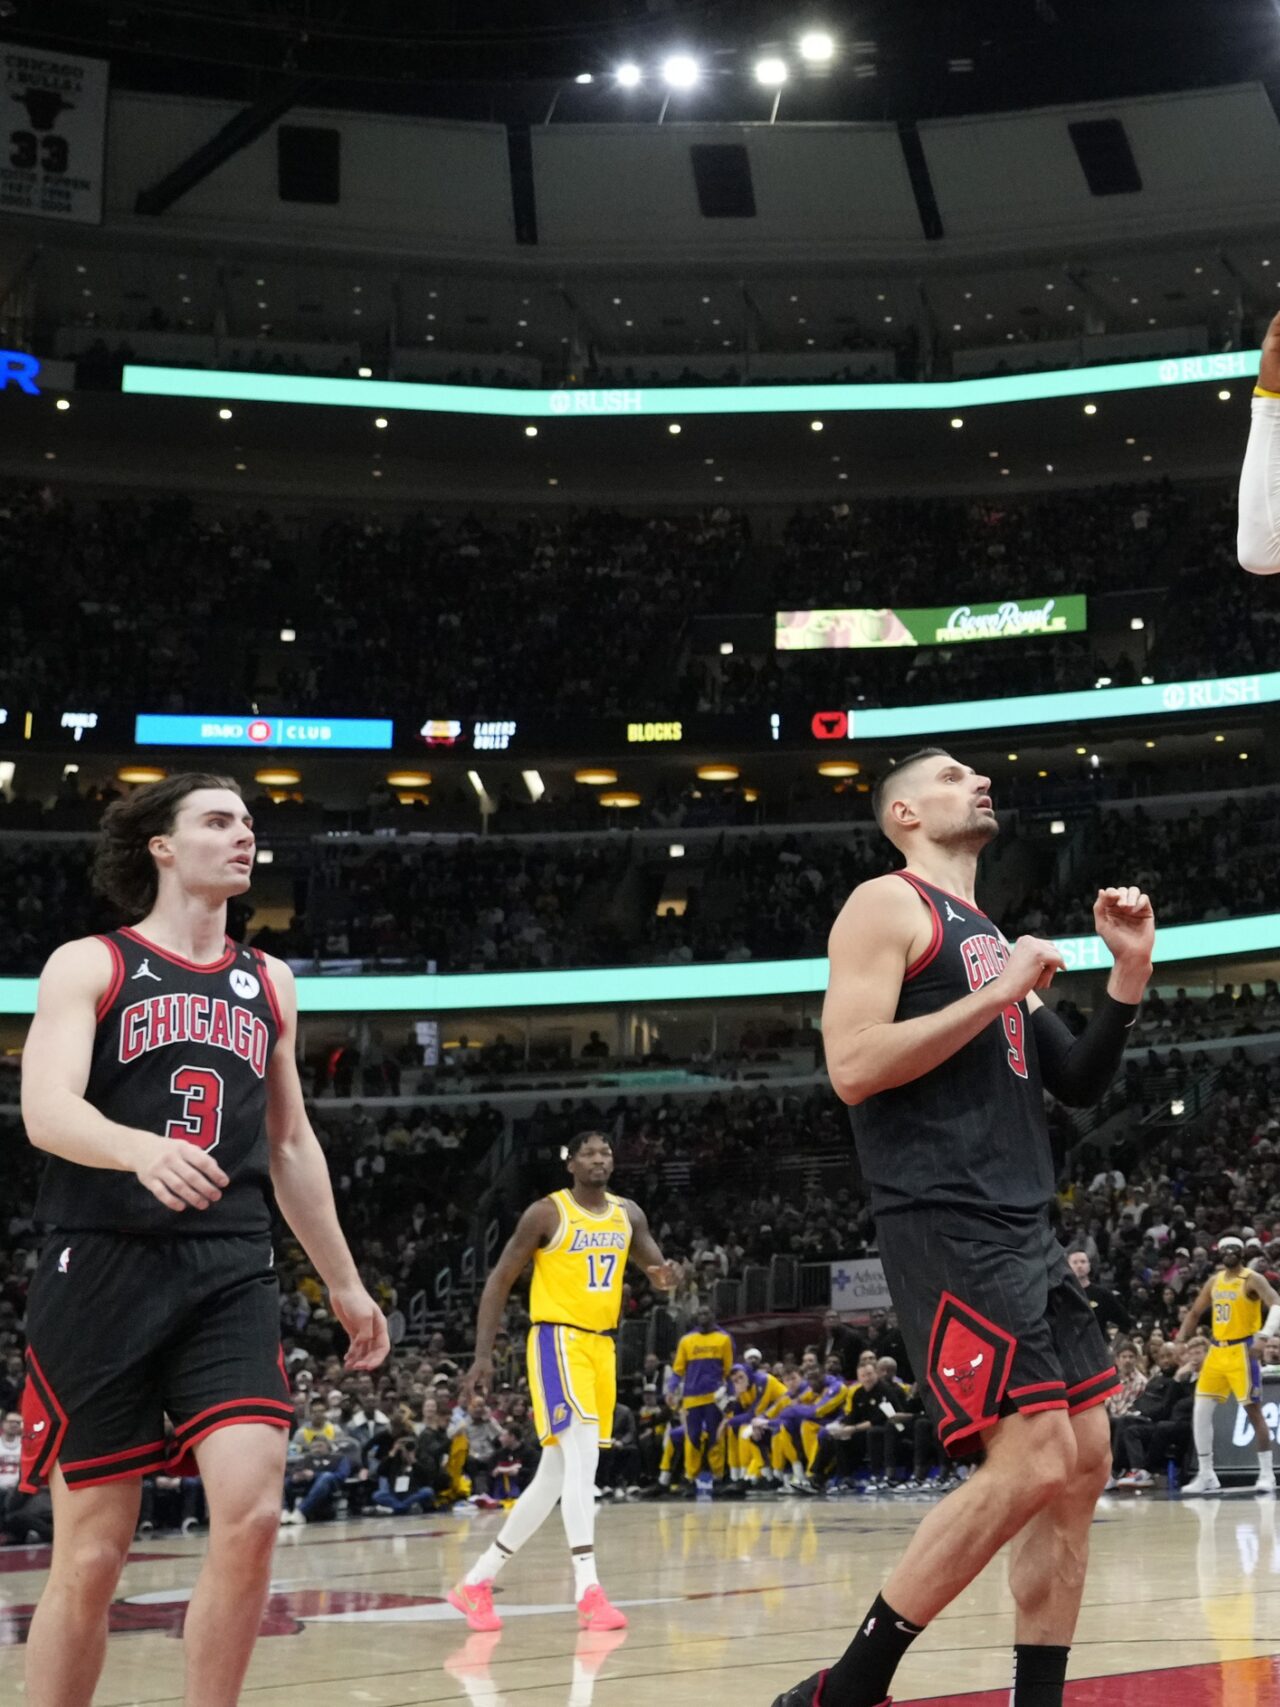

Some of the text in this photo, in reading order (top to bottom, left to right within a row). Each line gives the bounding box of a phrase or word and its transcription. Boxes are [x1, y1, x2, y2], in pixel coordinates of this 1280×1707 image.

[9, 130, 69, 173] 33
[1182, 352, 1247, 380] RUSH
[574, 390, 643, 412] RUSH
[1188, 676, 1262, 707] RUSH
[286, 726, 332, 740] CLUB
[628, 722, 682, 742] BLOCKS
[960, 933, 1011, 992] CHIC
[119, 993, 269, 1078] CHICAGO
[1001, 1001, 1029, 1080] 9
[165, 1065, 224, 1154] 3
[567, 1229, 626, 1253] LAKERS
[586, 1253, 617, 1292] 17
[1214, 1302, 1231, 1323] 30
